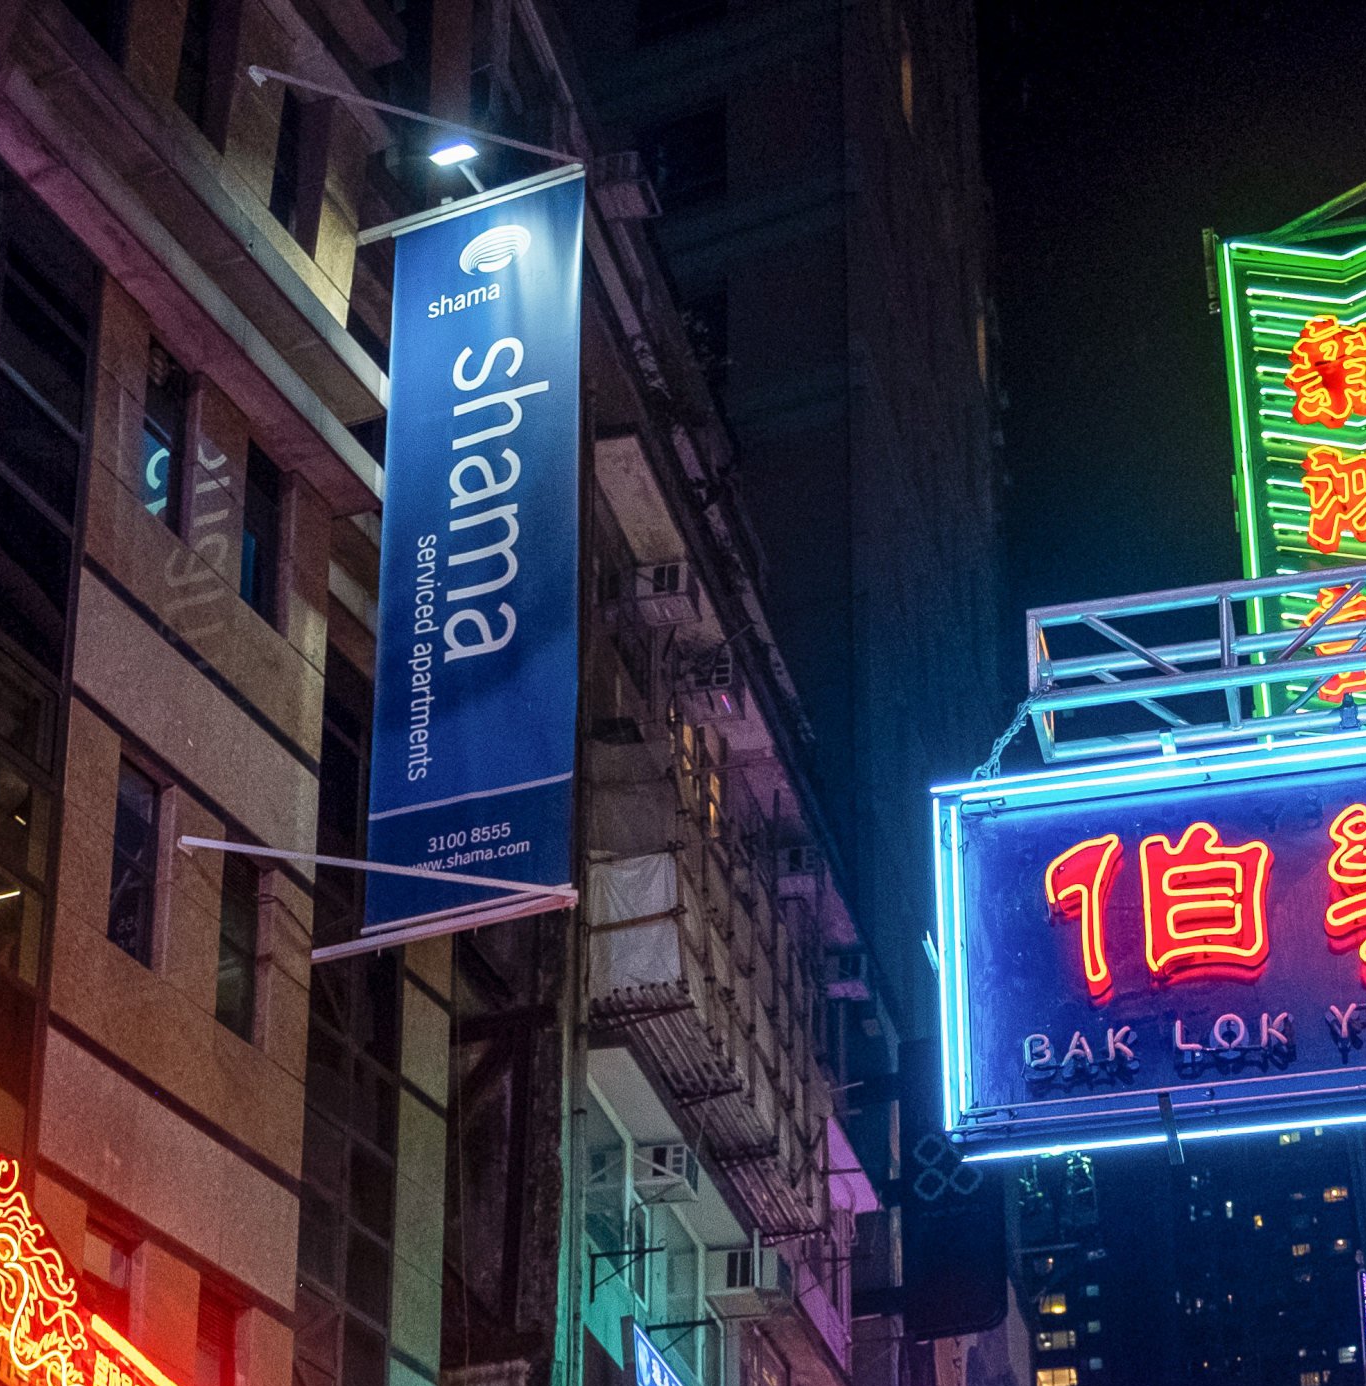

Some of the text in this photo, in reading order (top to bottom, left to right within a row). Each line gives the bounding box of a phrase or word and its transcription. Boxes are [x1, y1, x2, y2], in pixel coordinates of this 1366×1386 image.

[427, 281, 501, 319] shama
[443, 335, 550, 664] shama
[407, 533, 443, 784] serviced apartments
[426, 821, 511, 854] 3100 8555
[1021, 1026, 1138, 1068] BAK
[1174, 1010, 1292, 1054] LOK
